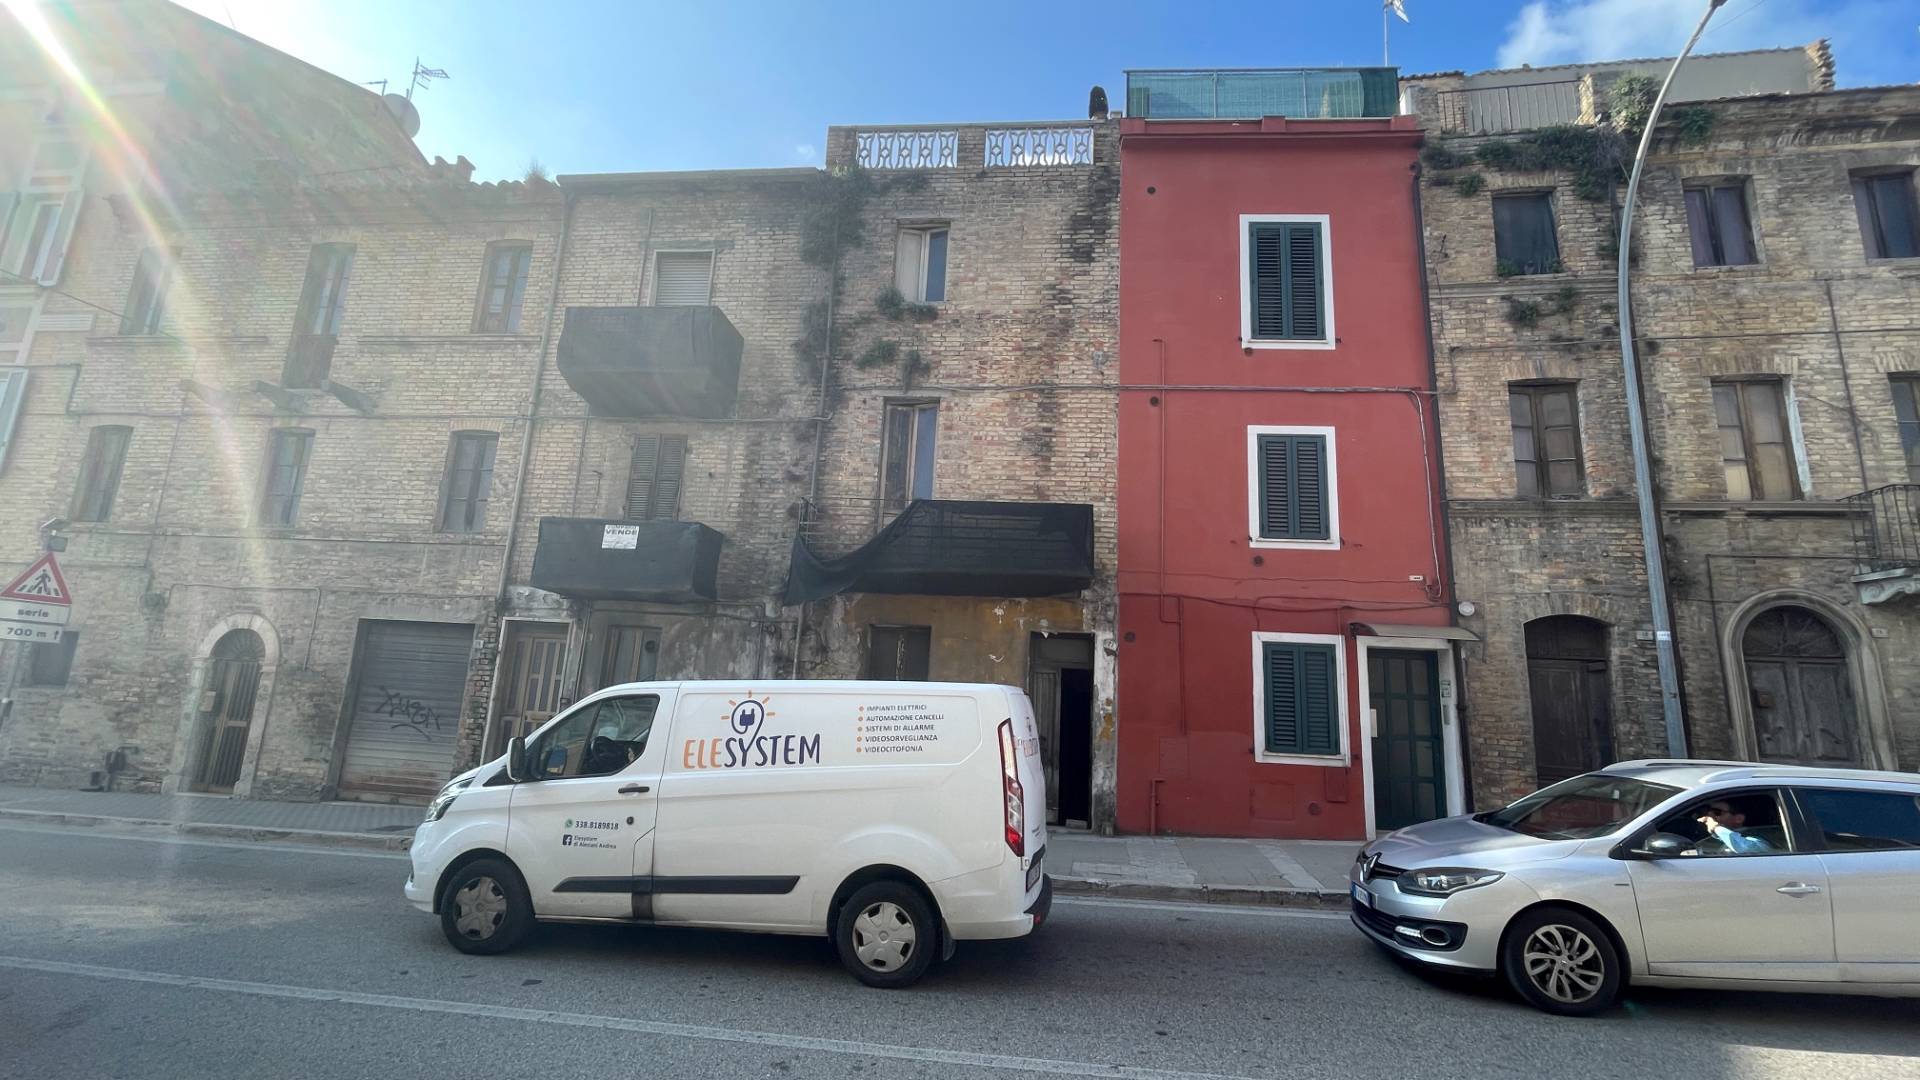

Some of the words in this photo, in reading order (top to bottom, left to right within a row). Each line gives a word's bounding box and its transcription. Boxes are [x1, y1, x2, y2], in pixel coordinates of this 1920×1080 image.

[7, 627, 33, 637] 700
[866, 714, 914, 722] AUTOMAZIONE
[914, 713, 945, 721] CANCELLI
[865, 734, 938, 743] VIDEOSORVEGLIANZA
[683, 733, 821, 769] ELESYSTEM
[864, 745, 924, 753] VIDEOCITOFONIA
